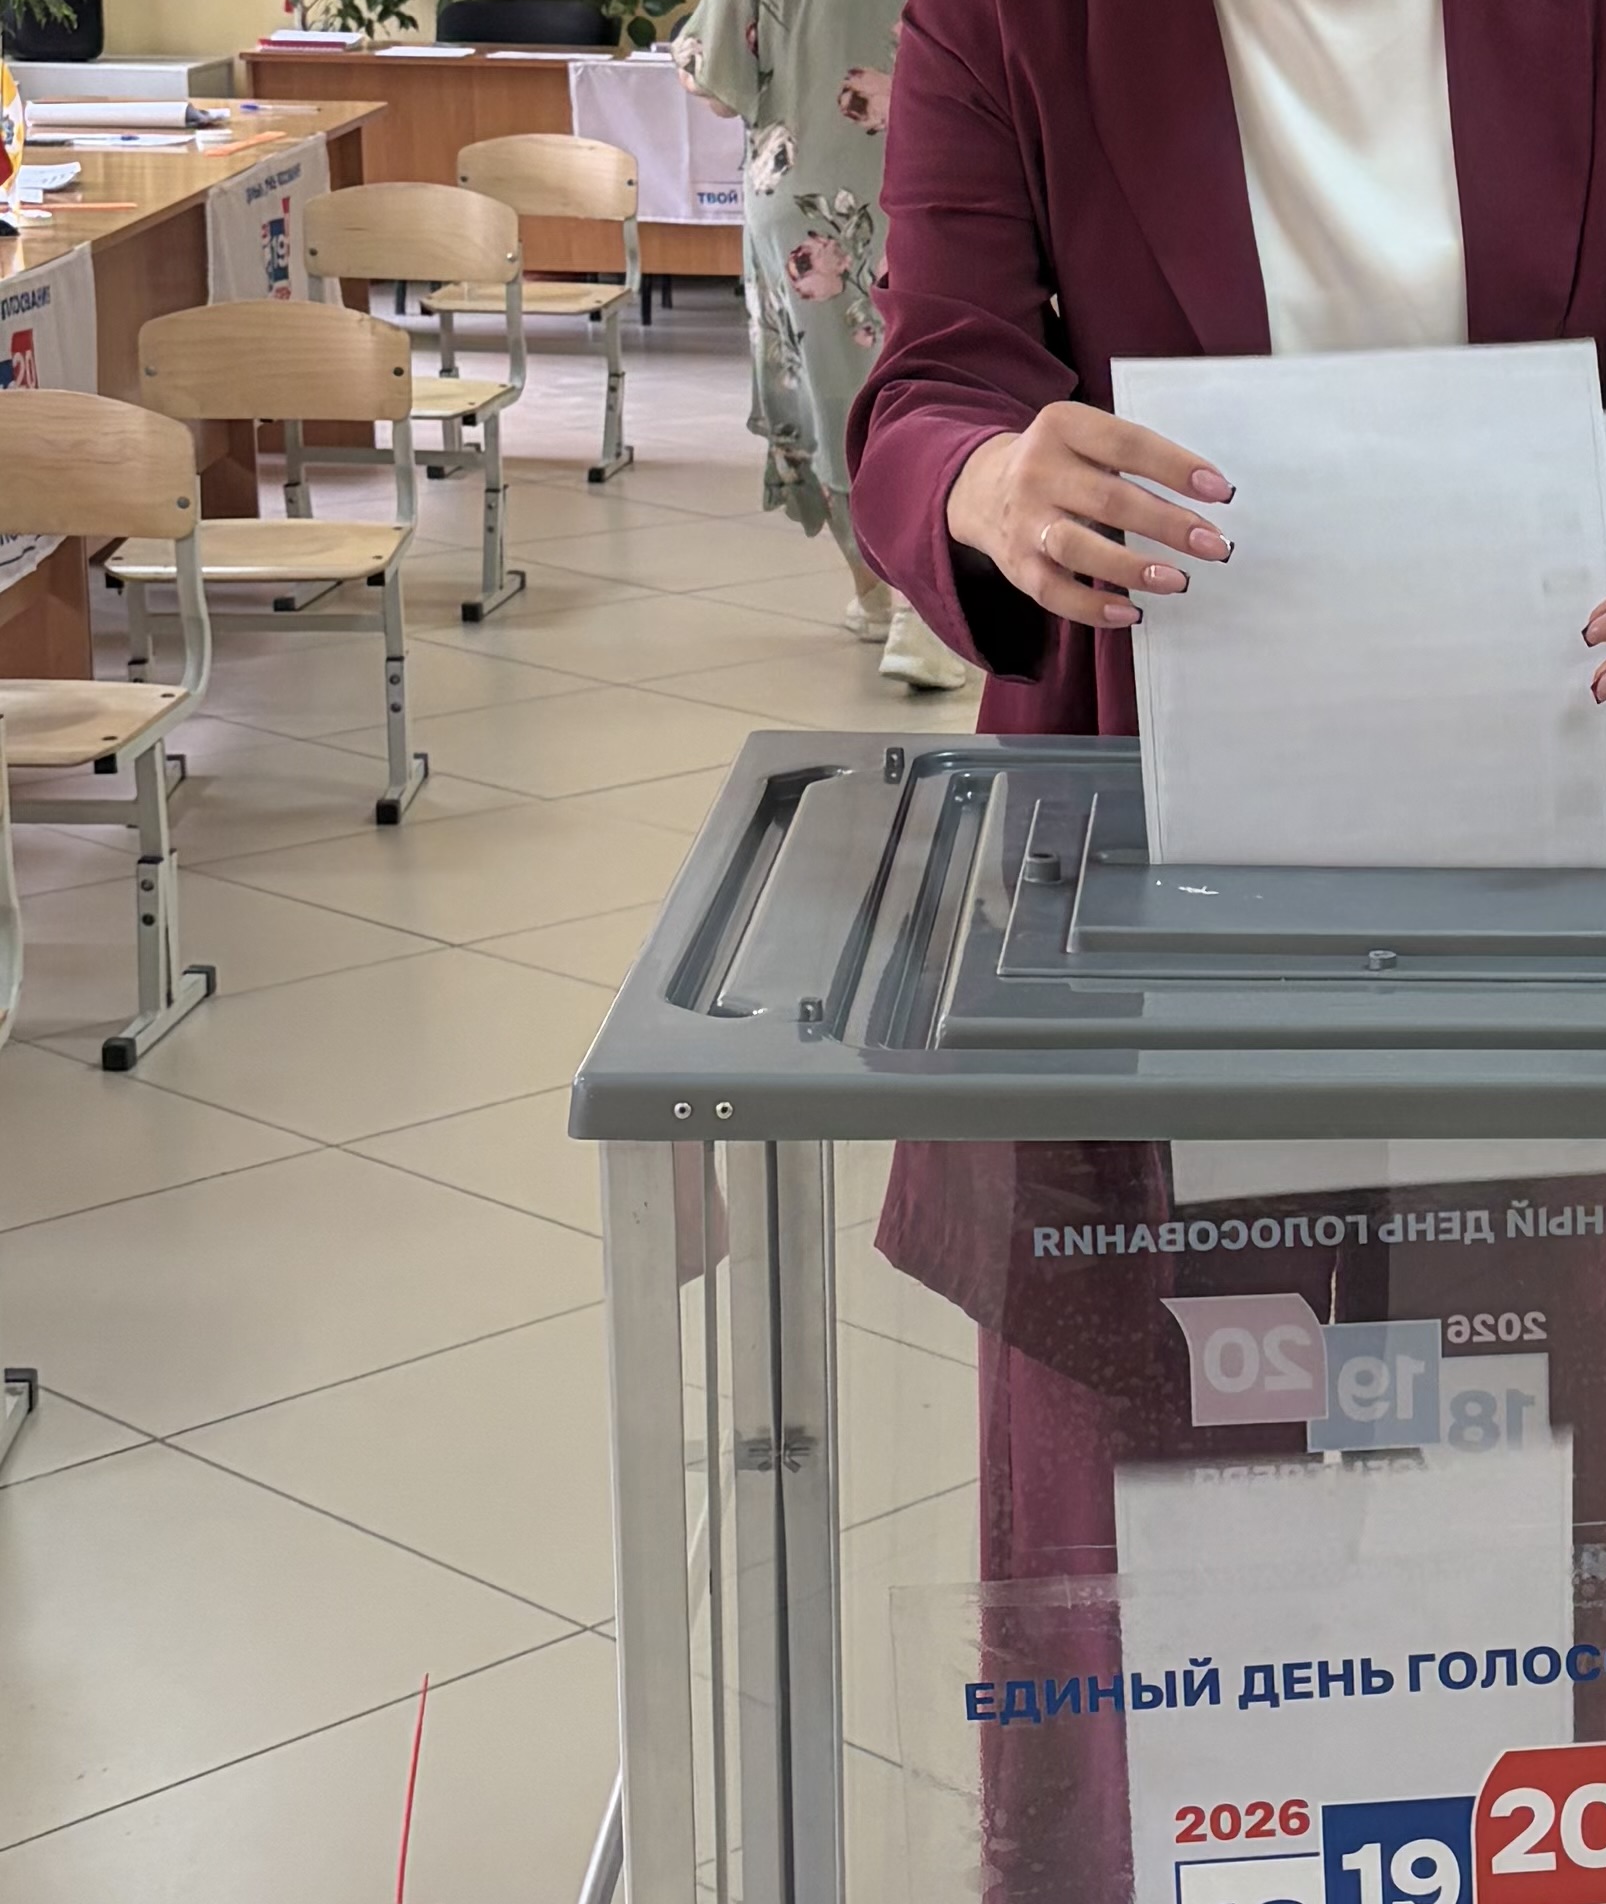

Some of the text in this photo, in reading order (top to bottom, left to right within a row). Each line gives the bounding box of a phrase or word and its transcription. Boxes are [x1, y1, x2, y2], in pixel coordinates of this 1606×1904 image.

[697, 189, 739, 205] ТВОЙ
[964, 1657, 1222, 1726] ЕДИНЫЙ
[1237, 1657, 1395, 1711] ДЕНЬ
[1174, 1798, 1311, 1844] 2026
